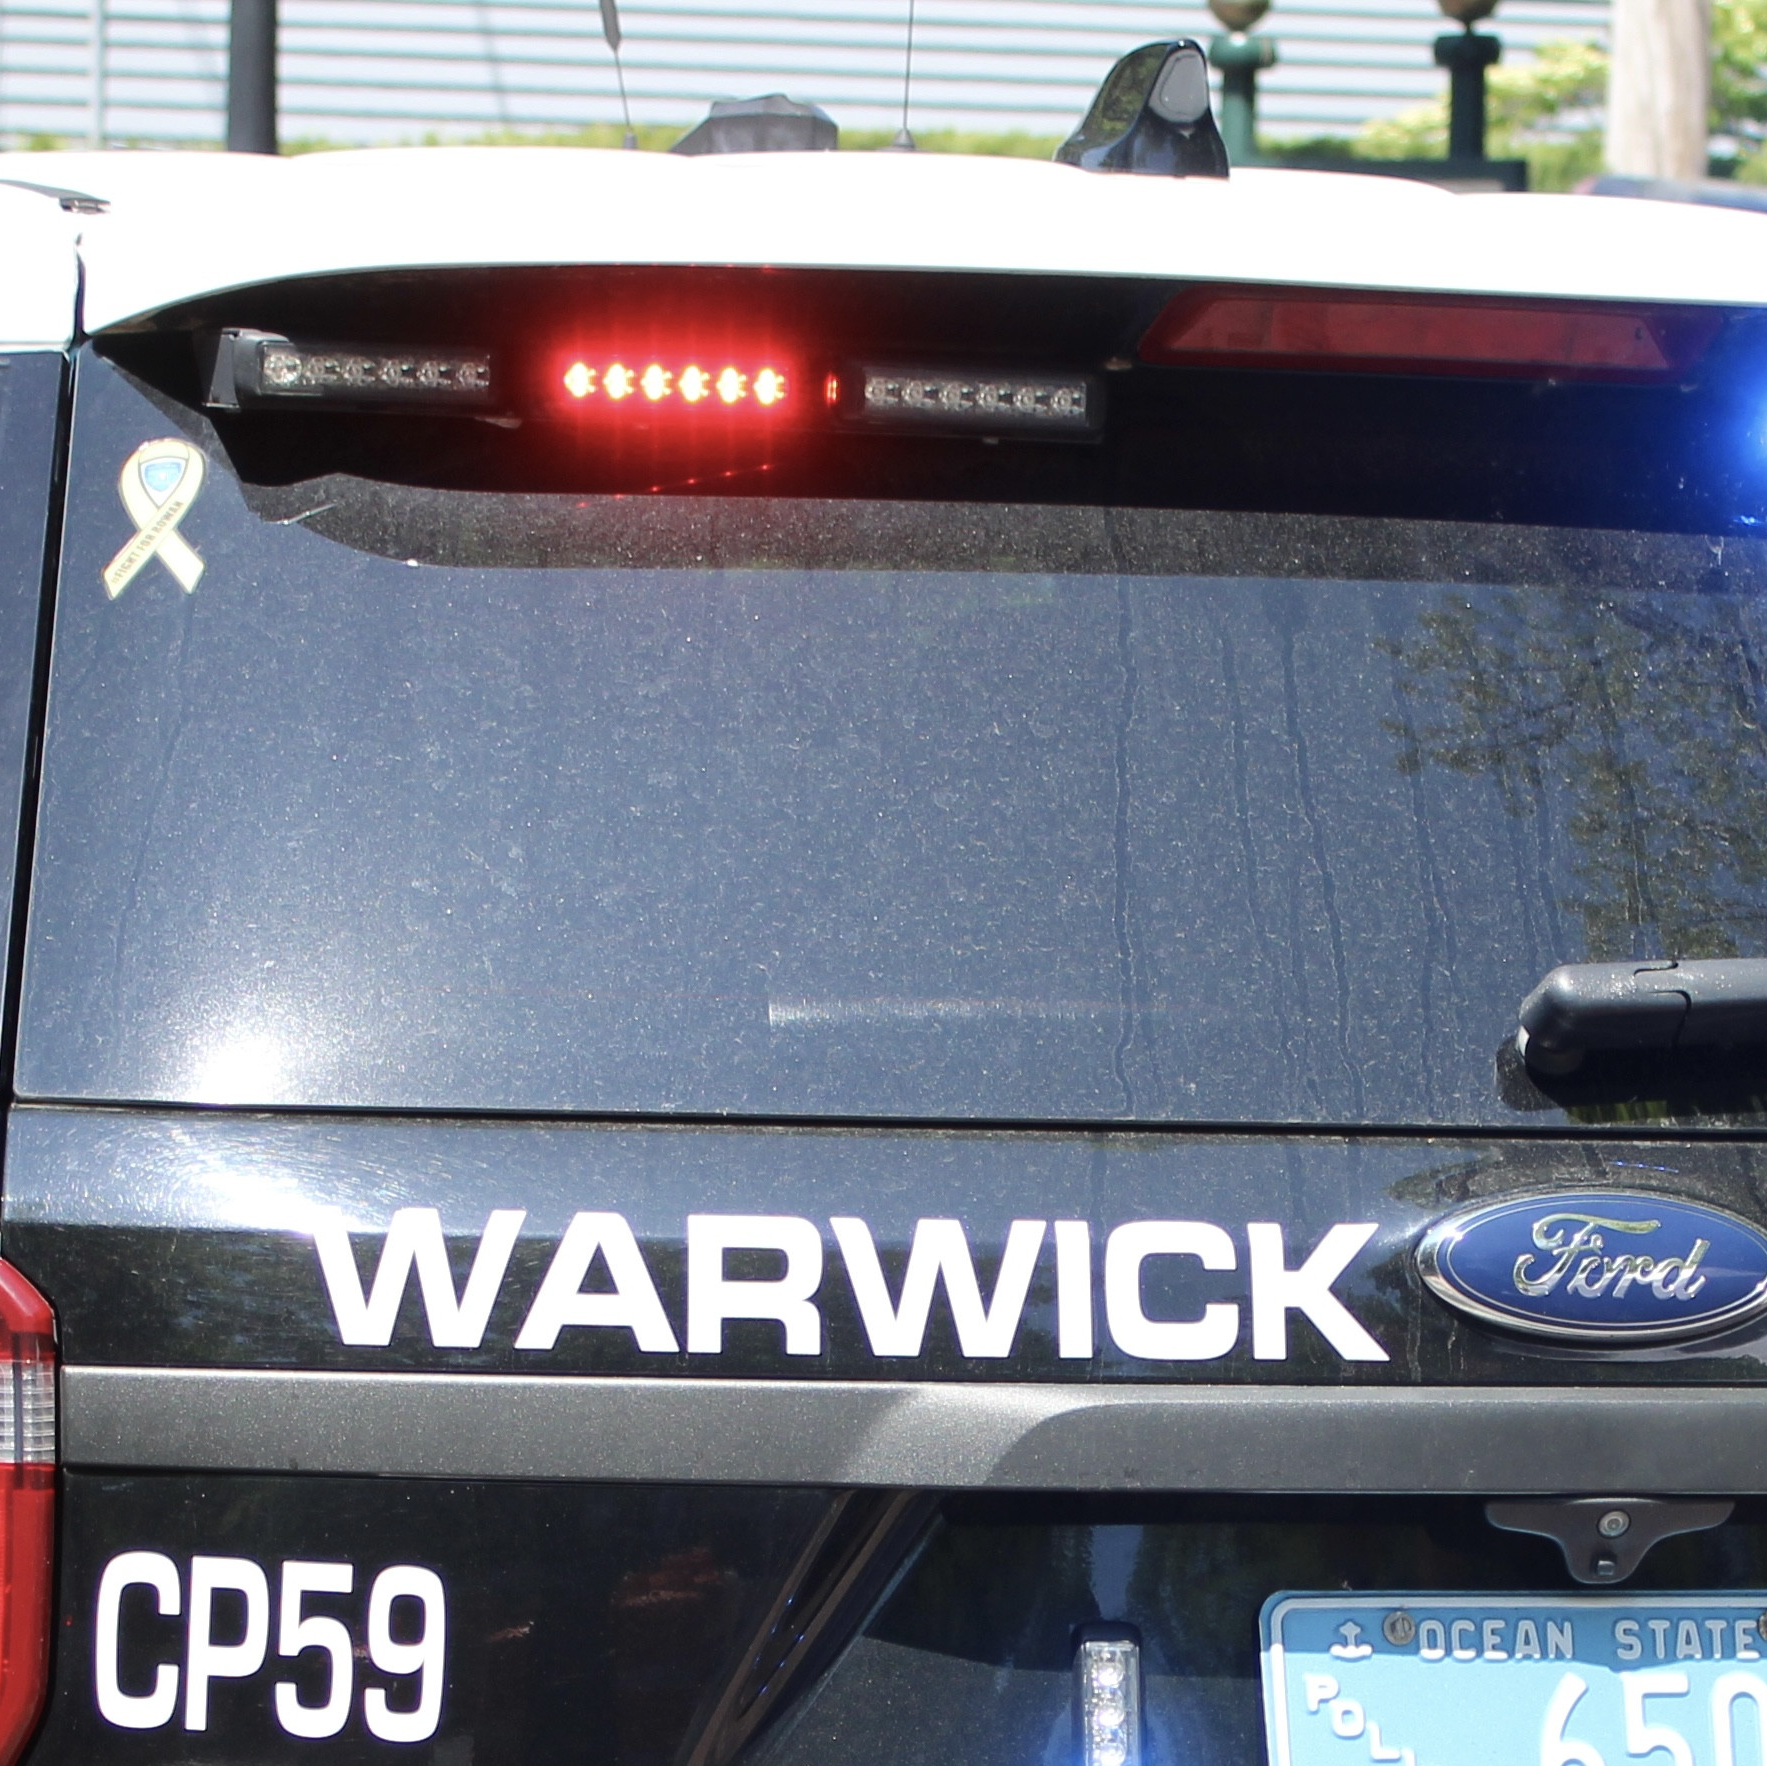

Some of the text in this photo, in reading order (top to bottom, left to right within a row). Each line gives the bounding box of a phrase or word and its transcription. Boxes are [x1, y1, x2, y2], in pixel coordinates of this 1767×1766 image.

[137, 533, 155, 552] FOR
[309, 1207, 1391, 1361] WARWICK
[1513, 1213, 1711, 1300] Ford
[95, 1550, 446, 1743] CP59
[1419, 1619, 1762, 1661] OCEAN STATE
